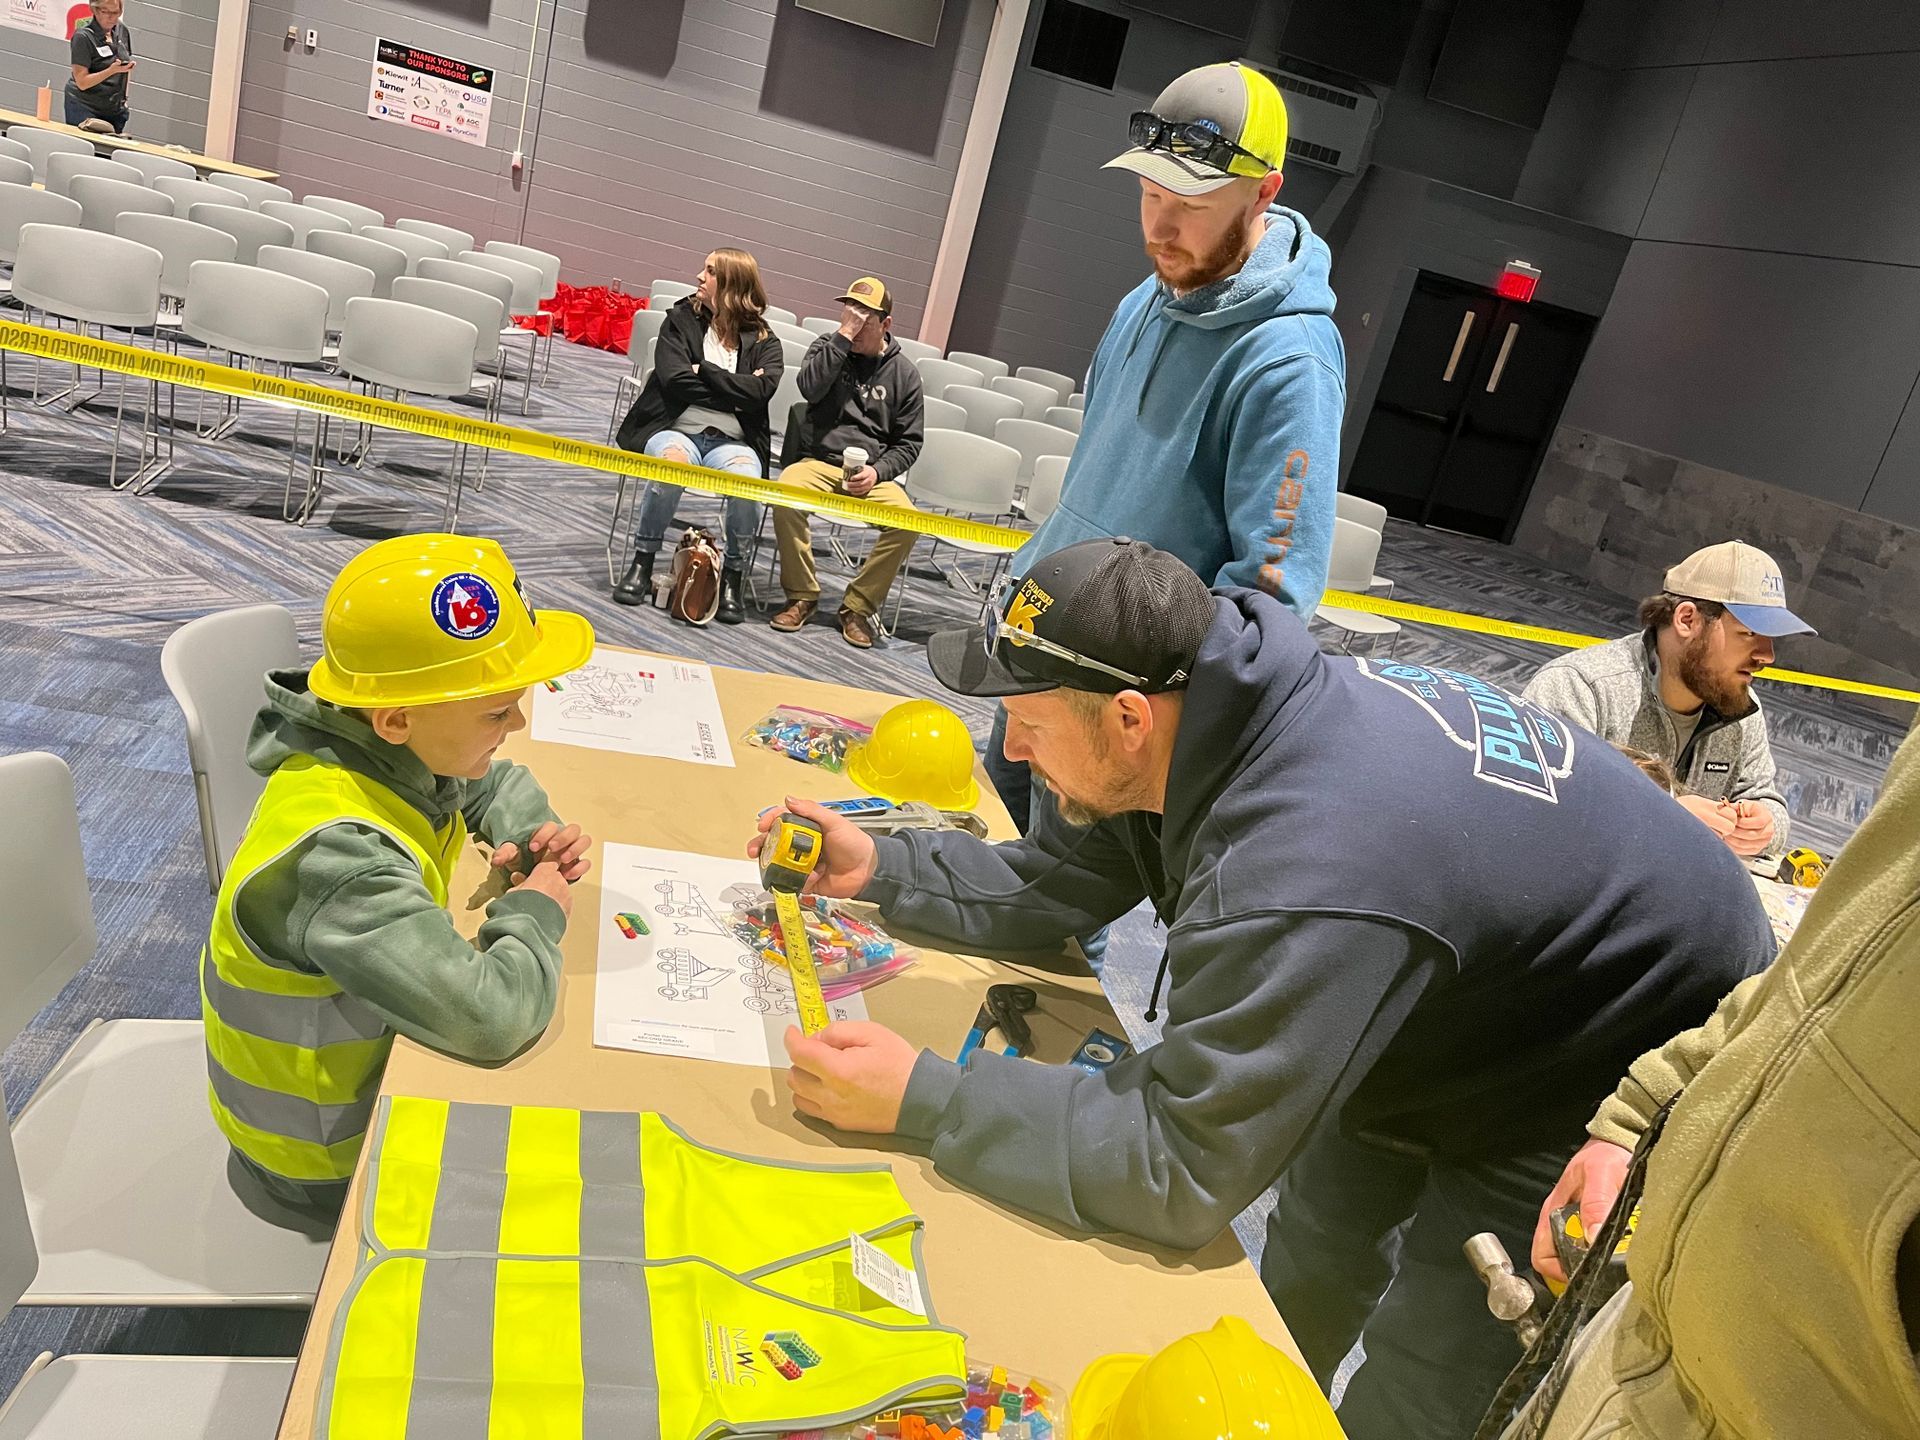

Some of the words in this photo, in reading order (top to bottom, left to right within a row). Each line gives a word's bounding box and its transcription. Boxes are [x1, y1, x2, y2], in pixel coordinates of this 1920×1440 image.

[407, 58, 424, 69] OUR
[425, 63, 470, 81] SPONSORS!
[408, 50, 437, 64] THANK
[438, 58, 455, 69] YOU
[455, 63, 467, 72] TO
[378, 79, 405, 94] Turner
[385, 69, 409, 82] Kiewit
[1021, 584, 1048, 612] LOCAL
[1025, 578, 1055, 607] PLUMBERS
[732, 1328, 767, 1387] NAWIC
